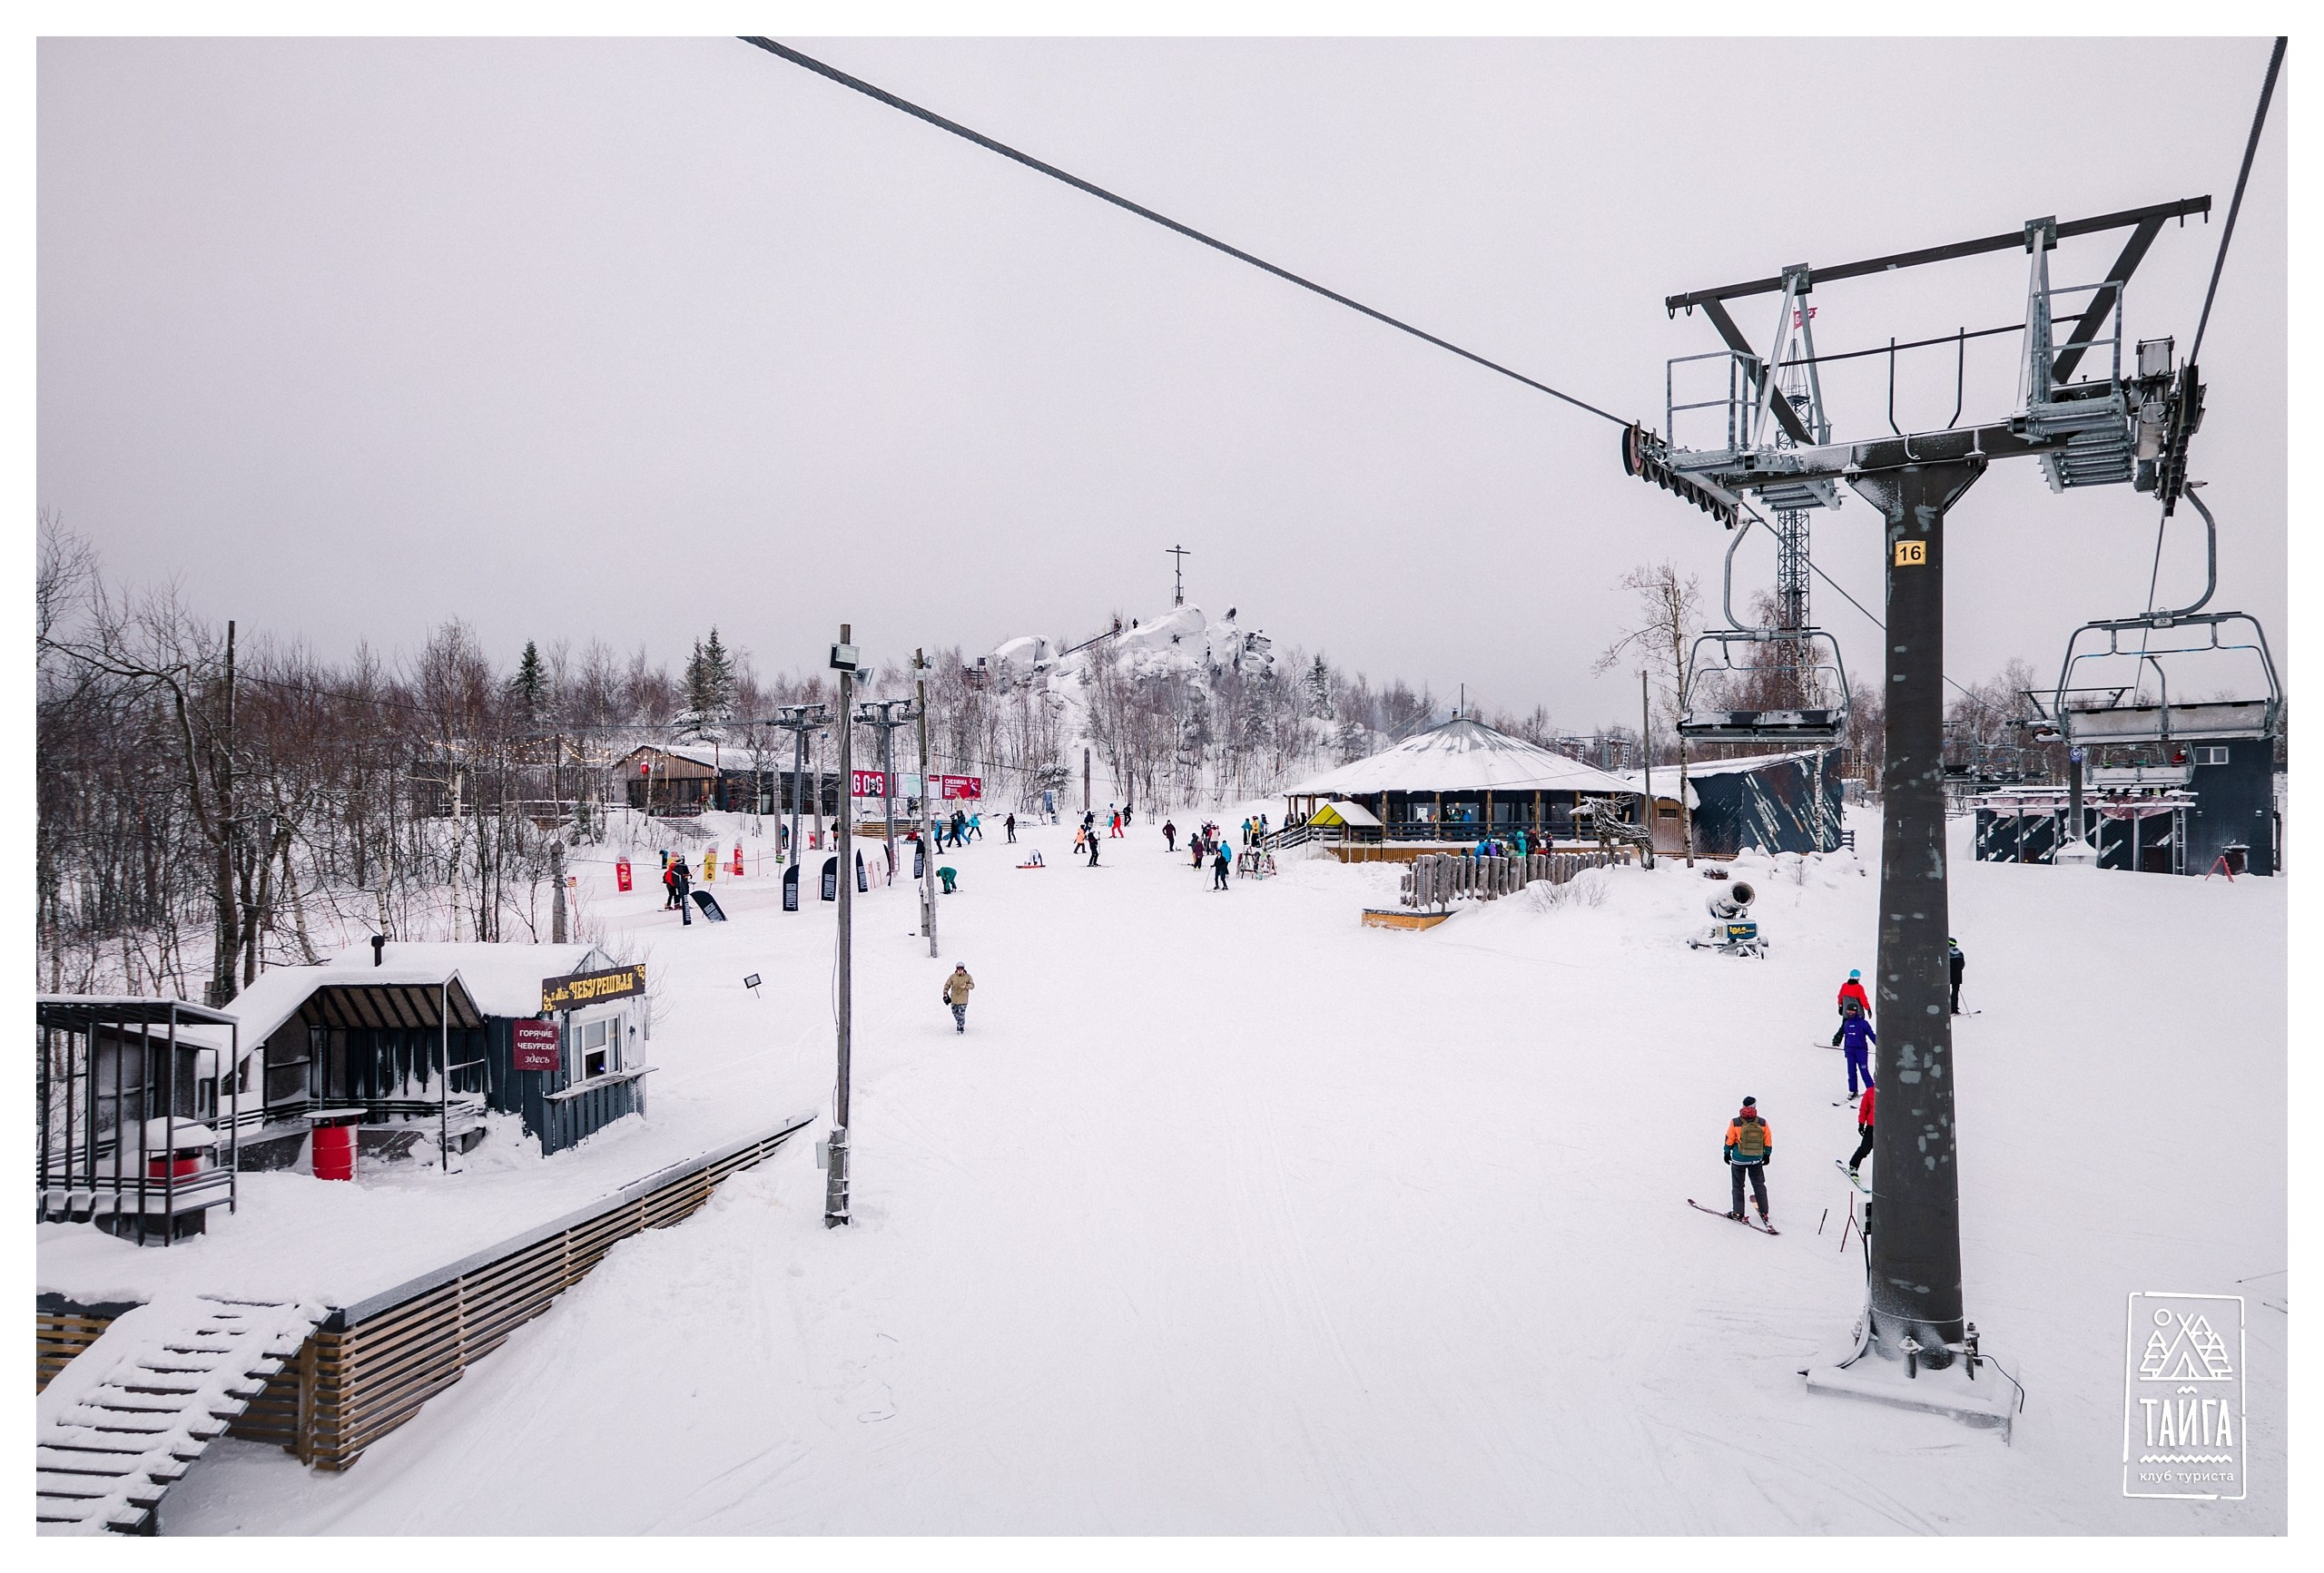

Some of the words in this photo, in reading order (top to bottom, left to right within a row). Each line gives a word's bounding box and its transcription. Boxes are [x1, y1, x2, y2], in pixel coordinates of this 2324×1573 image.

[1900, 546, 1921, 561] 16
[517, 1042, 556, 1050] ЧЕБУРЕКИ
[525, 1054, 550, 1064] здесь
